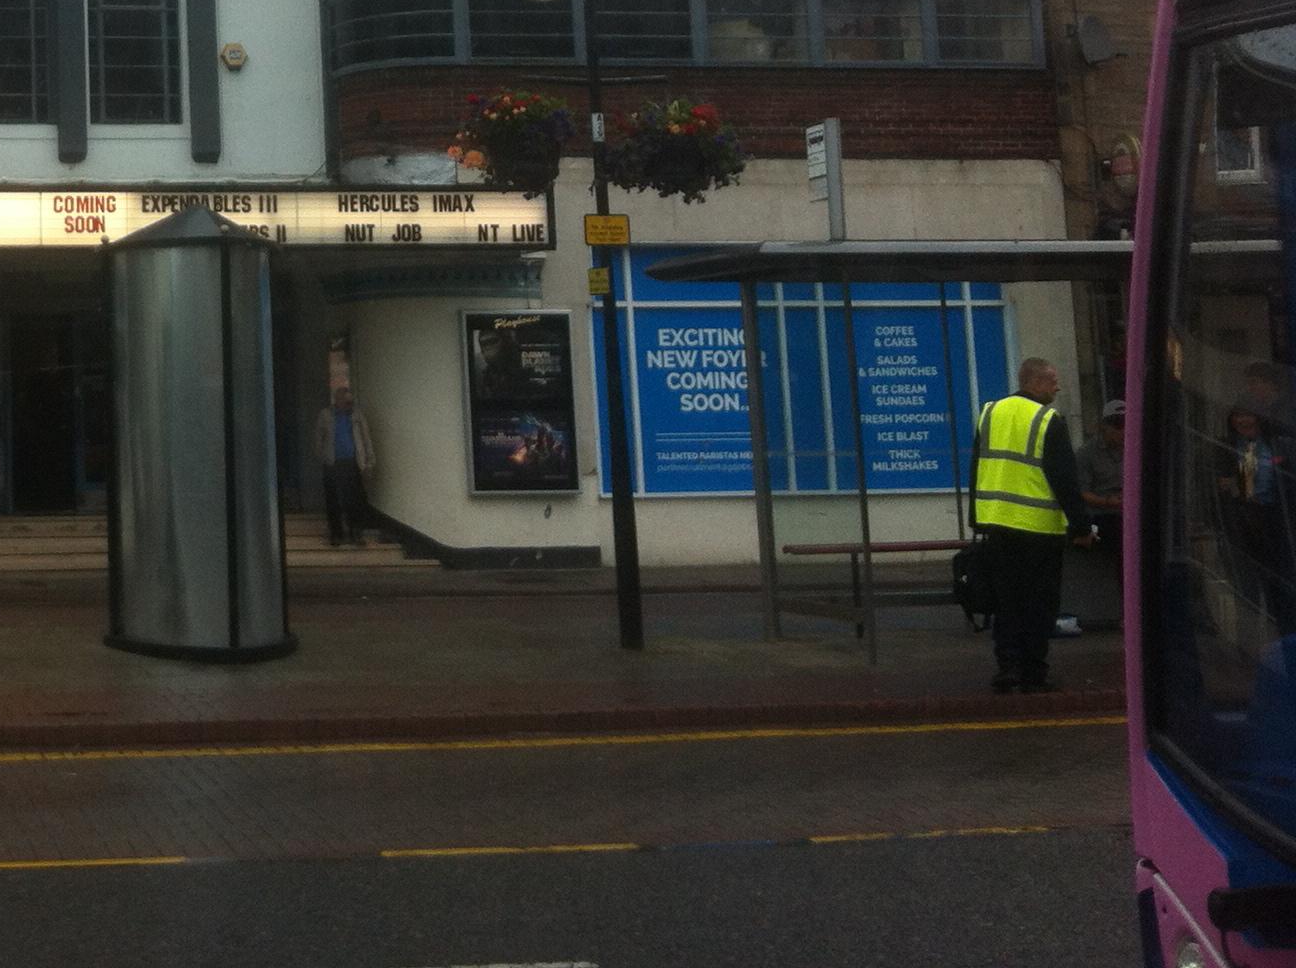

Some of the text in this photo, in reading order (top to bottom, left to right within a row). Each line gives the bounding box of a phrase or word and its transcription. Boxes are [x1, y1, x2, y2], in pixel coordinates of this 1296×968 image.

[53, 195, 116, 213] COMING
[338, 194, 475, 213] HERCULES IMAX
[64, 215, 106, 234] SOON
[345, 223, 545, 243] NUT JOB NT LIVE
[875, 326, 914, 336] COFFEE
[874, 337, 918, 347] & CAKES
[647, 350, 698, 368] NEW
[877, 355, 918, 365] SALADS
[869, 366, 938, 377] SANDWICHES
[666, 371, 748, 390] COMING
[872, 384, 927, 394] ICE CREAM
[876, 396, 925, 406] SUNDAES
[860, 413, 944, 424] FRESH POPCORN
[877, 431, 929, 441] ICE BLAST
[888, 449, 921, 459] THICK
[872, 461, 938, 471] MILKSHAKES
